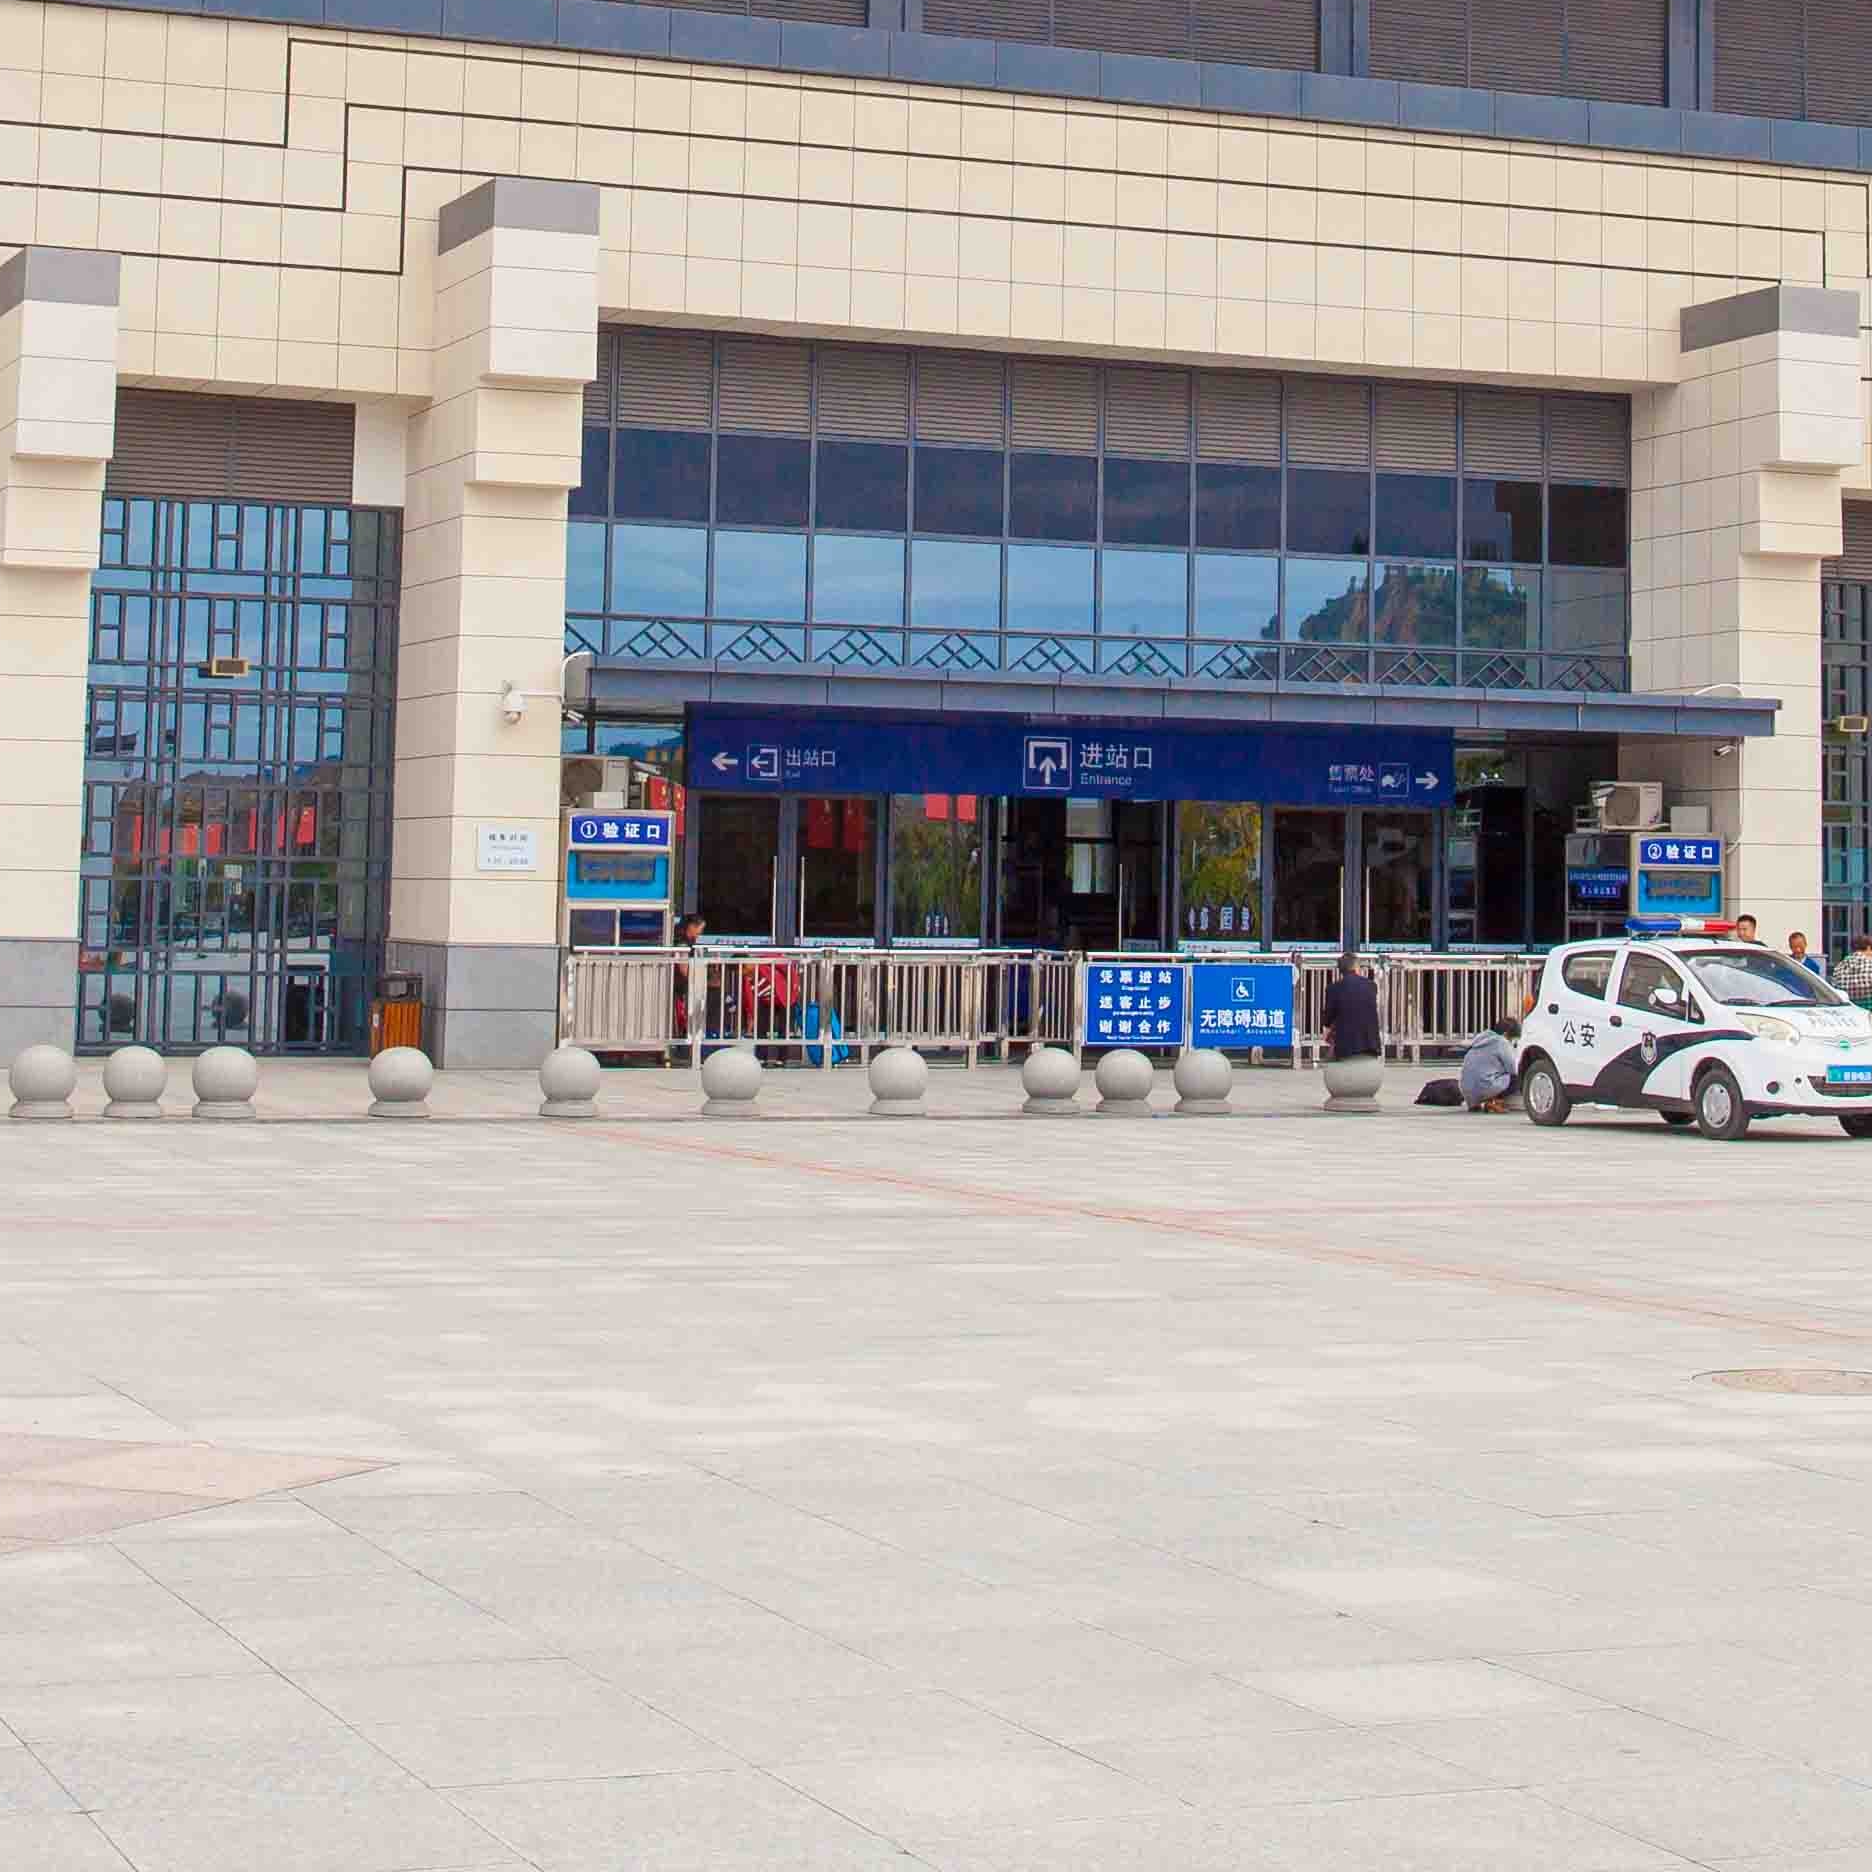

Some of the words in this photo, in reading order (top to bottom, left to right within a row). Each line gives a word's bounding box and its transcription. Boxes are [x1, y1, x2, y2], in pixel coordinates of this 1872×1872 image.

[785, 748, 836, 767] 出站口
[1079, 742, 1152, 769] 进站口
[1080, 773, 1132, 785] Entrance
[1099, 970, 1172, 984] 凭票进站
[1099, 995, 1172, 1010] 送客止步
[1099, 1019, 1171, 1034] 谢谢合作
[1200, 1009, 1286, 1028] 无障碍通道
[1562, 1020, 1595, 1048] 公安
